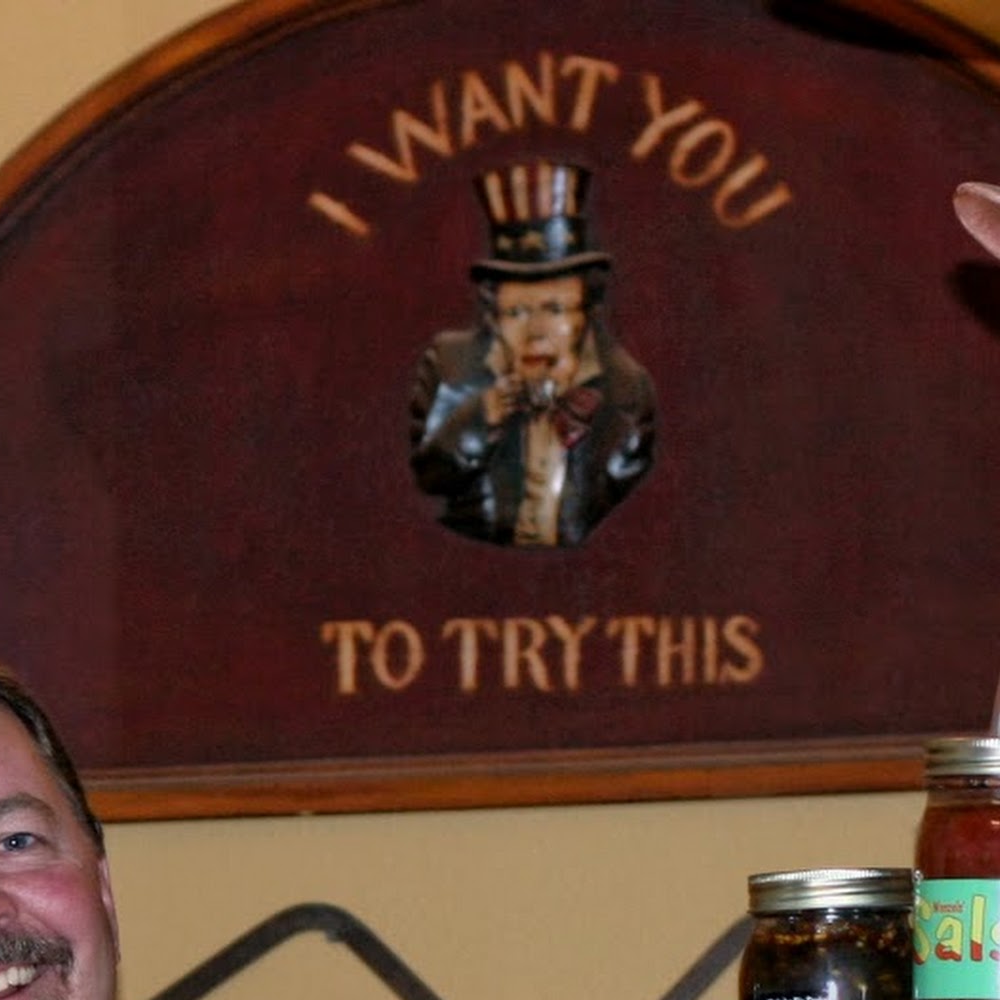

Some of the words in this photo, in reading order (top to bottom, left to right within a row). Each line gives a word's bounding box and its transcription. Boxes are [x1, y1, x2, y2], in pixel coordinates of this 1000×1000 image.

[308, 190, 371, 238] I
[346, 51, 620, 185] WANT
[630, 73, 792, 230] YOU
[320, 619, 426, 694] TO
[441, 614, 598, 692] TRY
[606, 613, 765, 687] THIS
